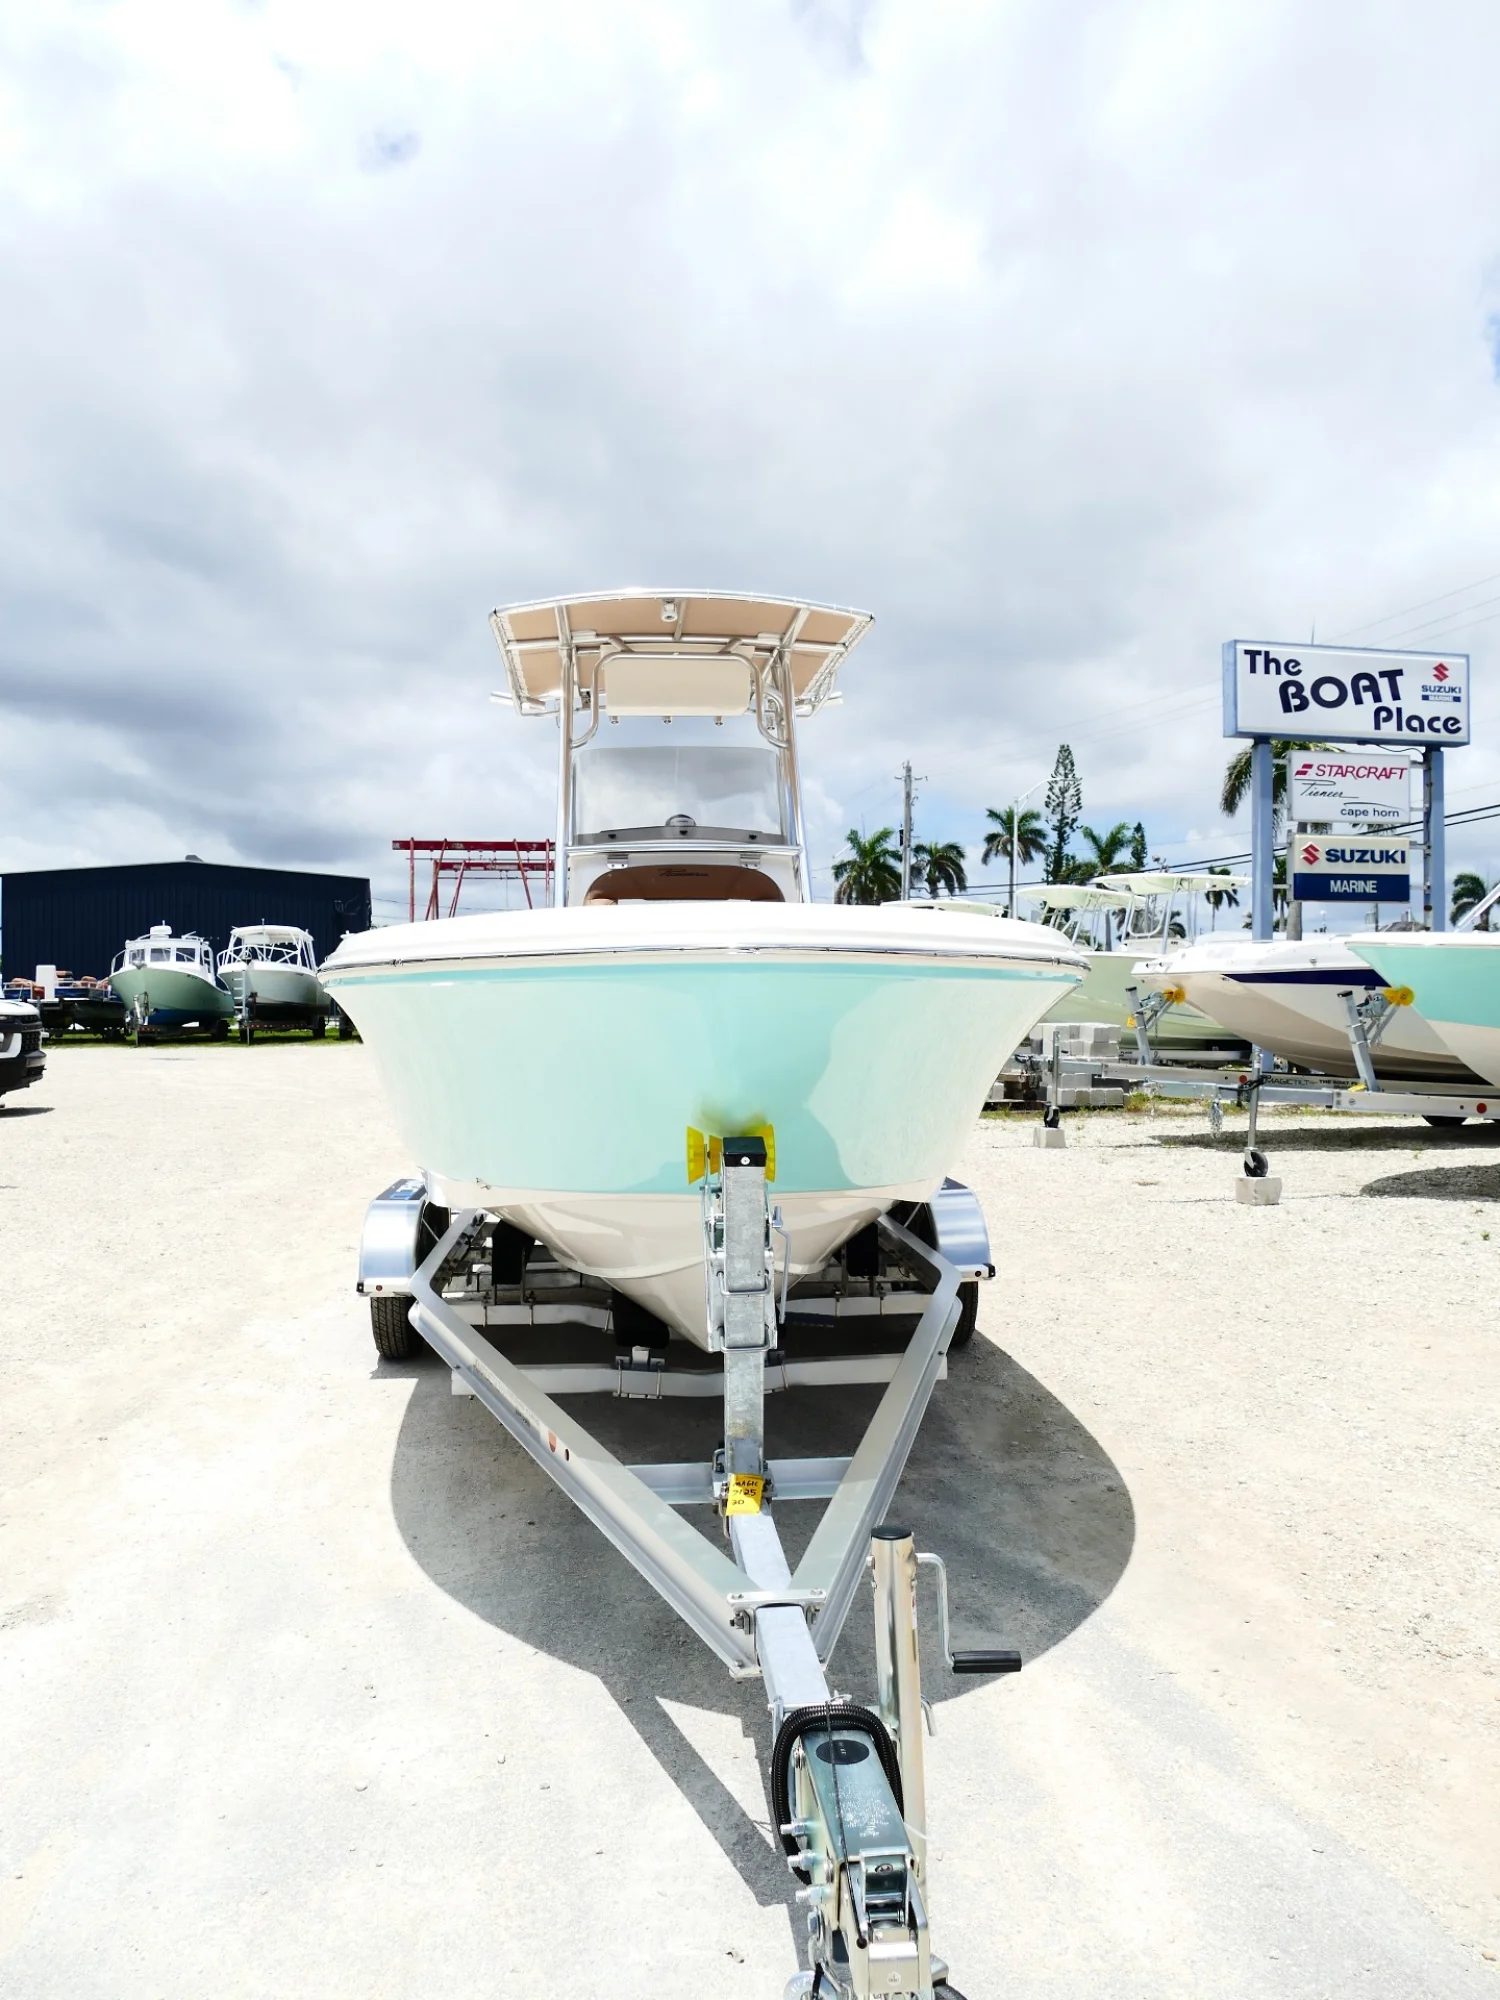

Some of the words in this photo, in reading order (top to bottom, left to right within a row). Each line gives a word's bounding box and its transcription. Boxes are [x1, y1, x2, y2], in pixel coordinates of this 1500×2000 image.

[1244, 649, 1302, 676] The
[1279, 669, 1404, 713] BOAT
[1421, 685, 1462, 694] SUZUKI
[1374, 706, 1462, 734] Place
[1315, 764, 1407, 780] STARCRAFT
[1294, 778, 1359, 798] Pioneer
[1340, 808, 1369, 818] cape
[1373, 808, 1399, 818] horn
[1325, 848, 1406, 864] SUZUKI
[1330, 880, 1377, 893] MARINE
